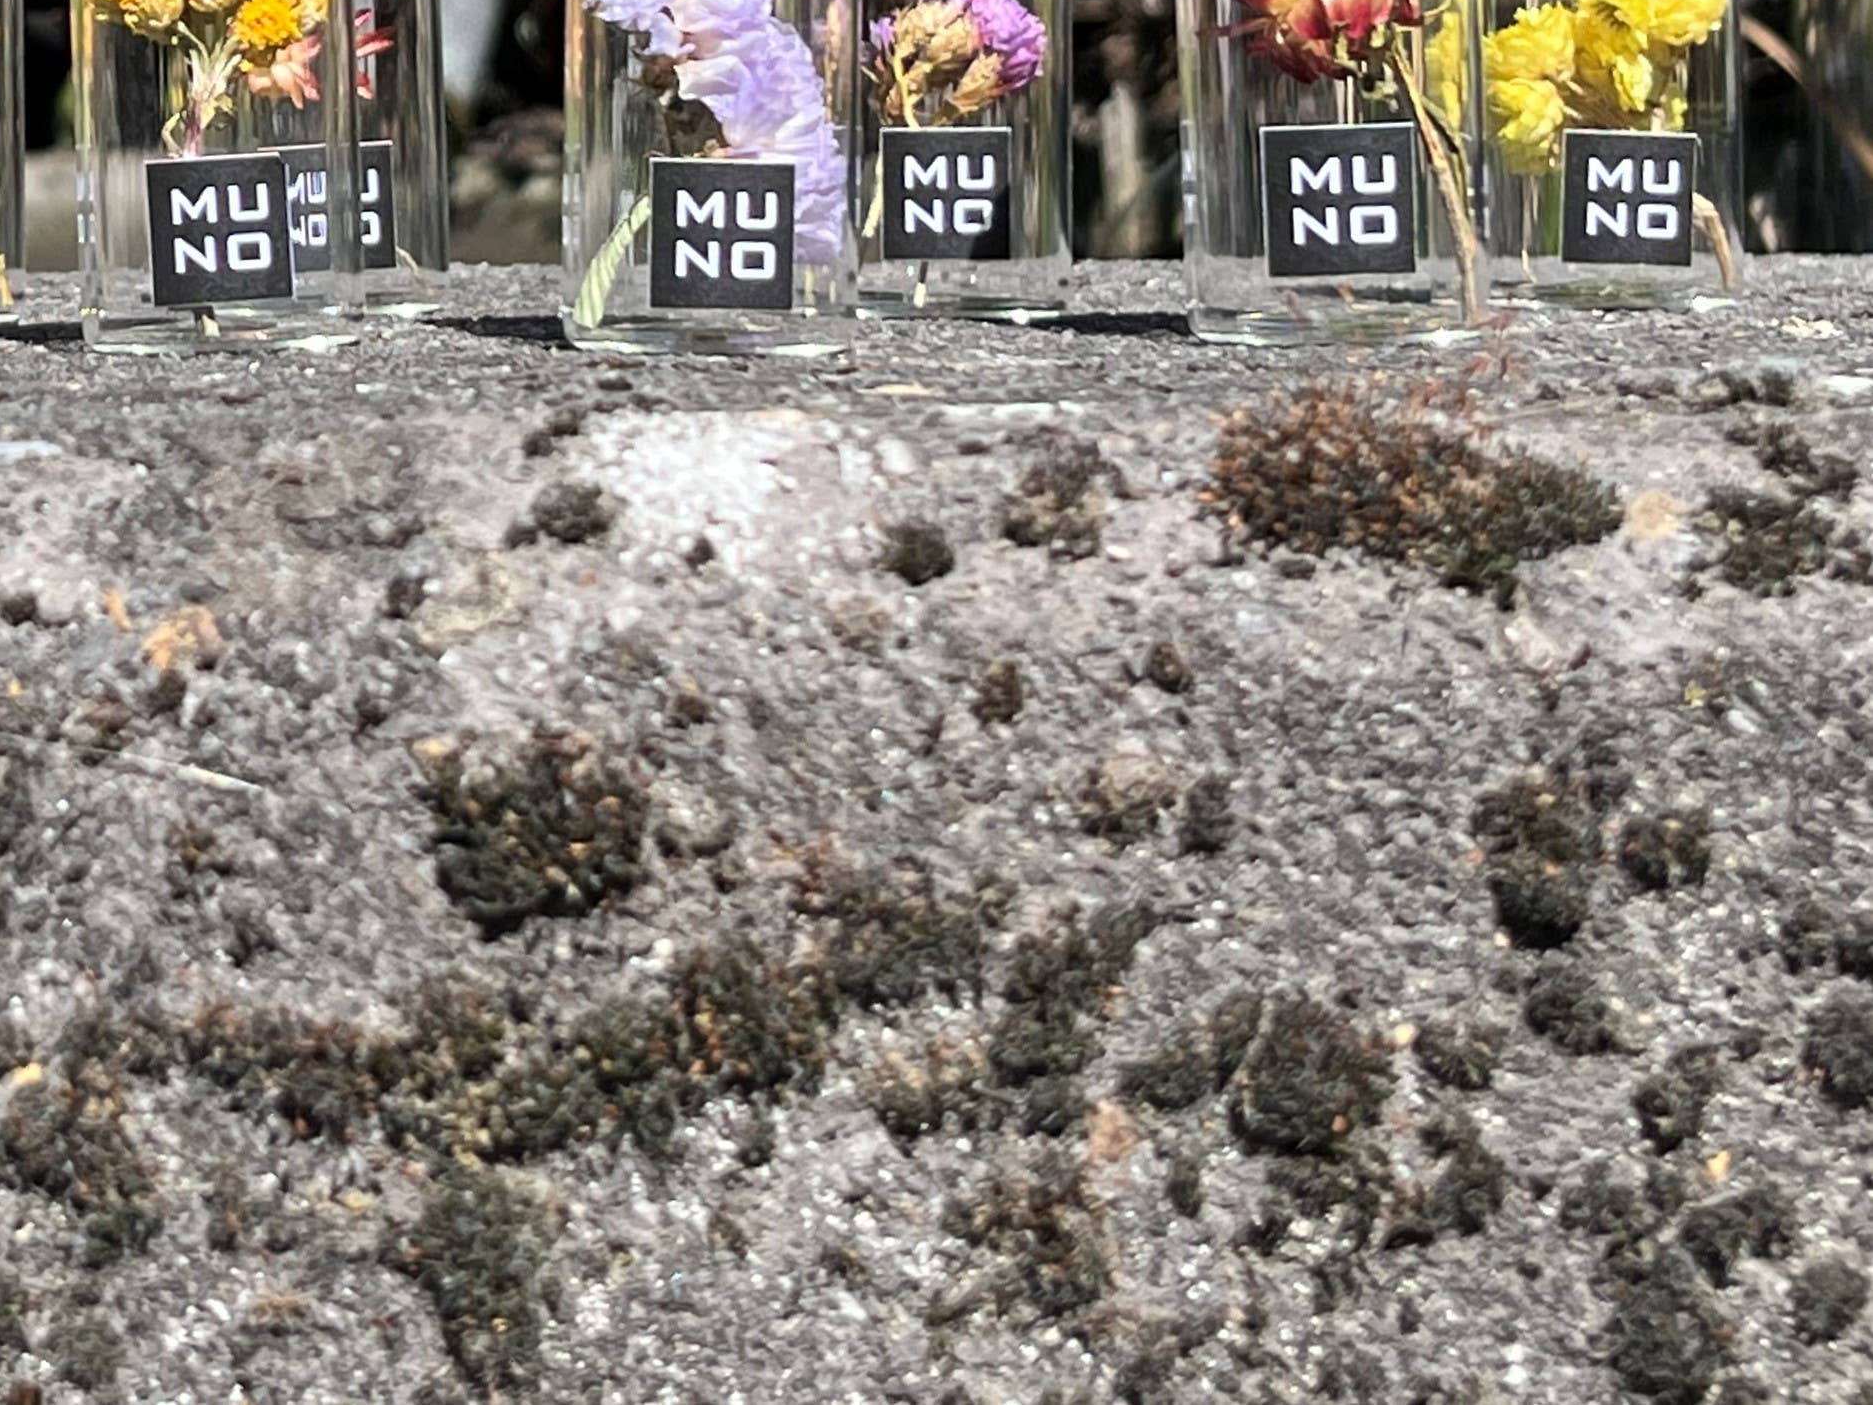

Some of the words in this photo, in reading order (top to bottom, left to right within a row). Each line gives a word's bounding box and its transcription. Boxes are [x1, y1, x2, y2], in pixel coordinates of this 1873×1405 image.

[903, 154, 996, 191] MU
[1290, 154, 1398, 196] MU
[1587, 156, 1681, 196] MU
[170, 182, 270, 226] MU
[676, 189, 779, 231] MU
[904, 198, 994, 236] NO
[1585, 201, 1679, 240] NO
[1292, 205, 1399, 246] NO
[173, 231, 273, 275] NO
[674, 239, 777, 281] NO
